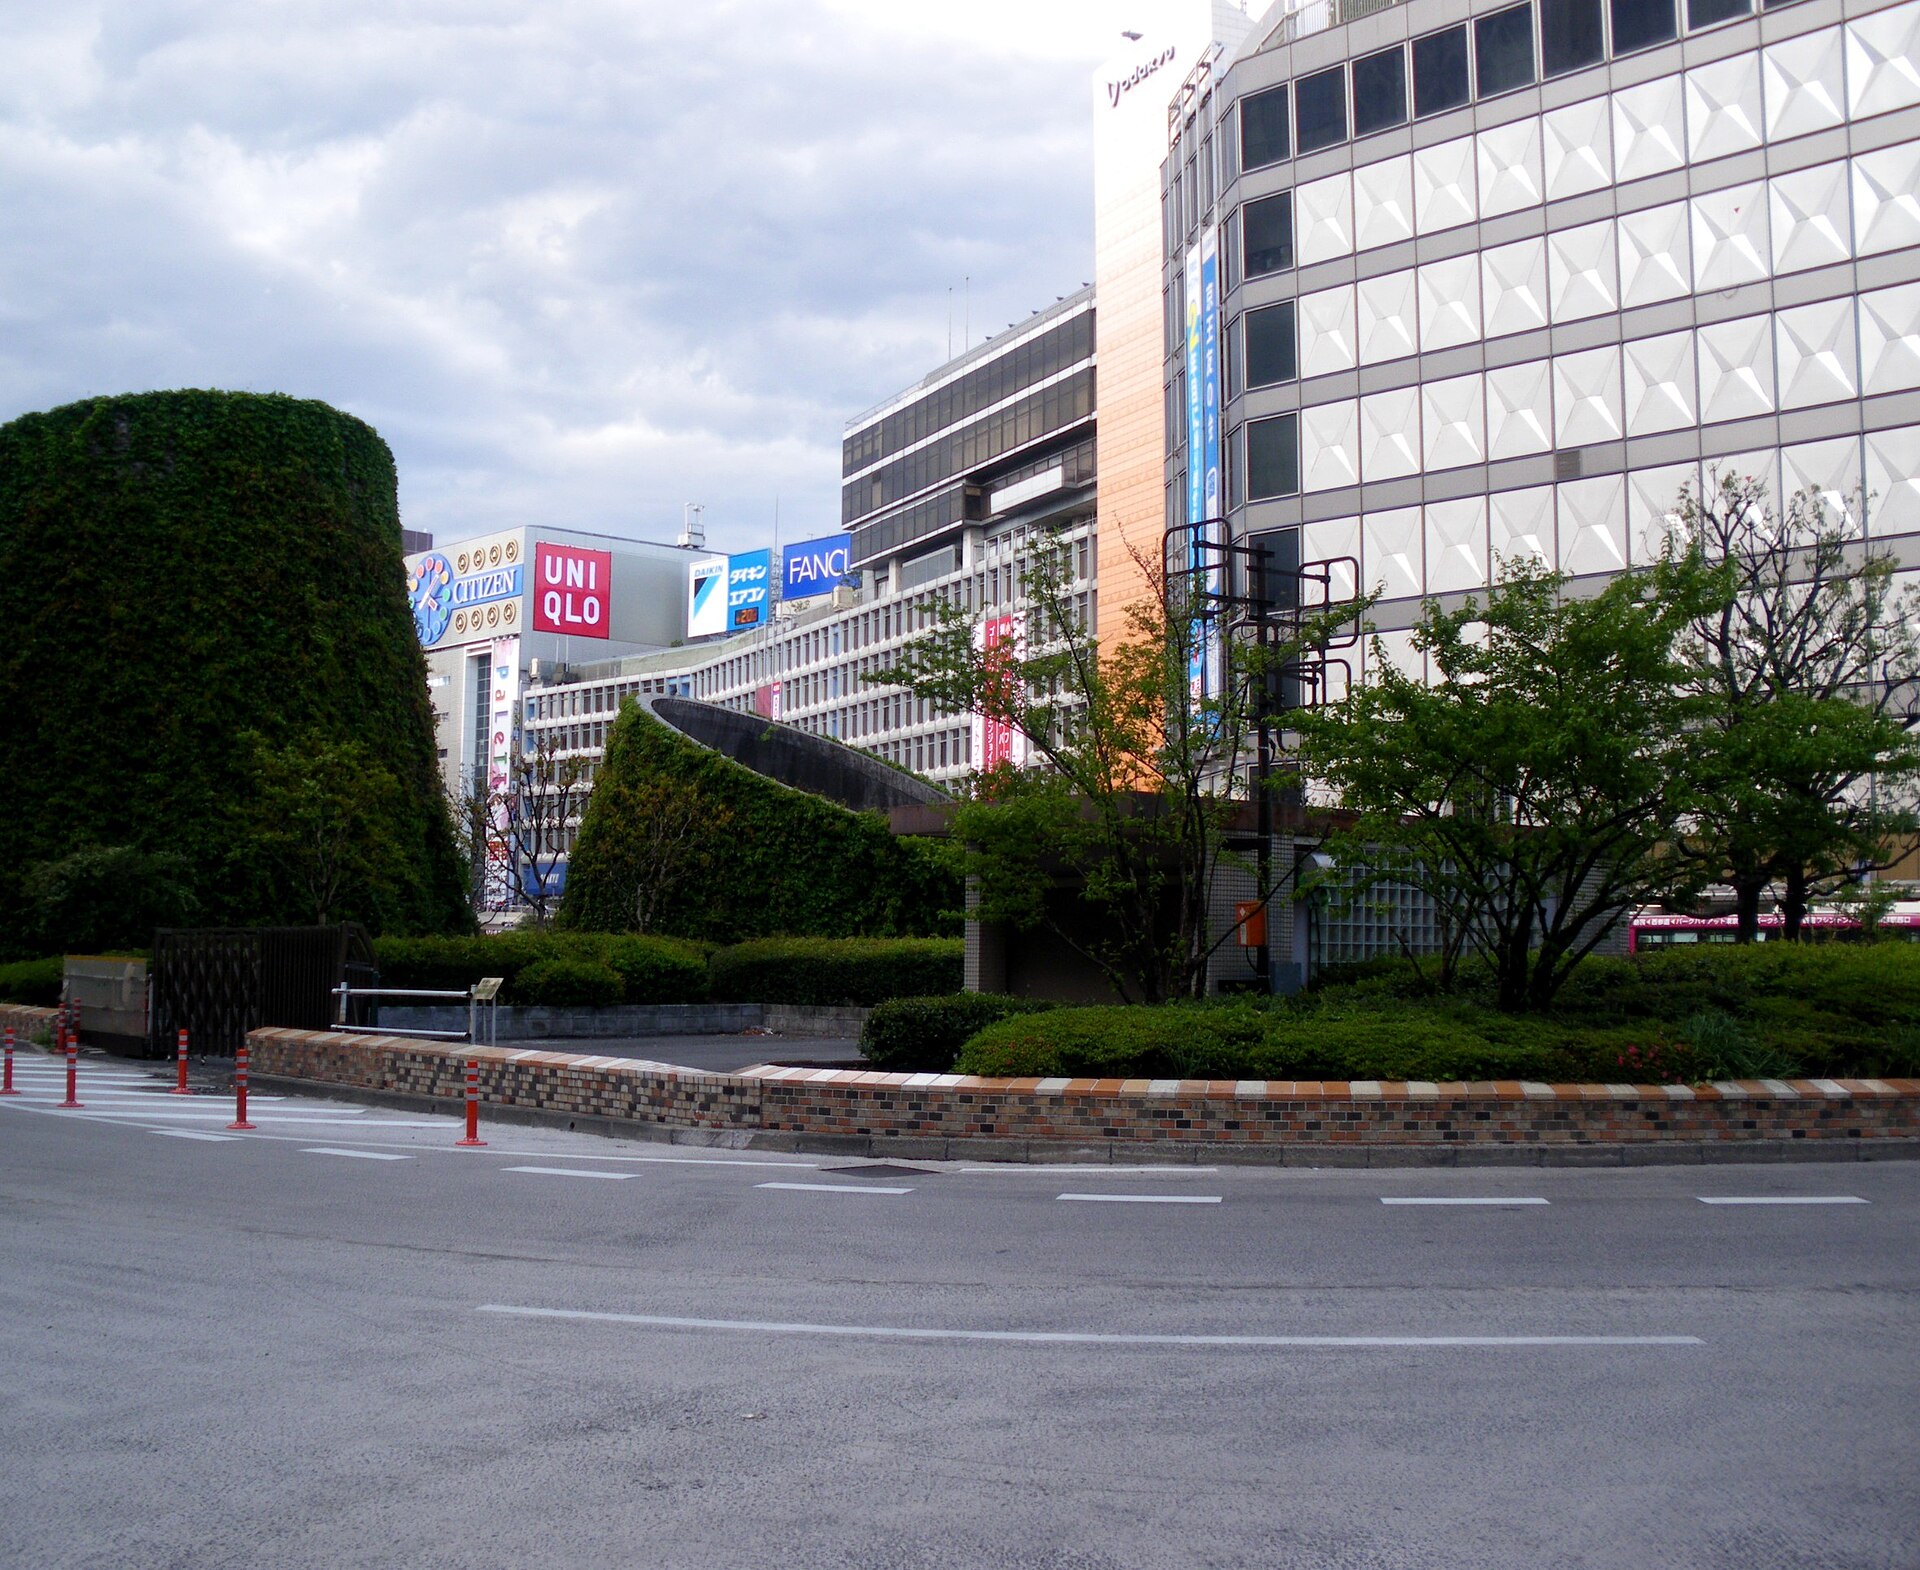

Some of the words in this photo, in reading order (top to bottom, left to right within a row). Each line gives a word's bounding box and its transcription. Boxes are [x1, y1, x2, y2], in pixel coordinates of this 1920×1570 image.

[545, 555, 596, 590] UNI
[694, 564, 724, 577] DAIKIN
[730, 565, 767, 585] ダイキン
[453, 569, 517, 604] CITIZEN
[729, 586, 766, 606] エアコン
[544, 590, 600, 626] QLO
